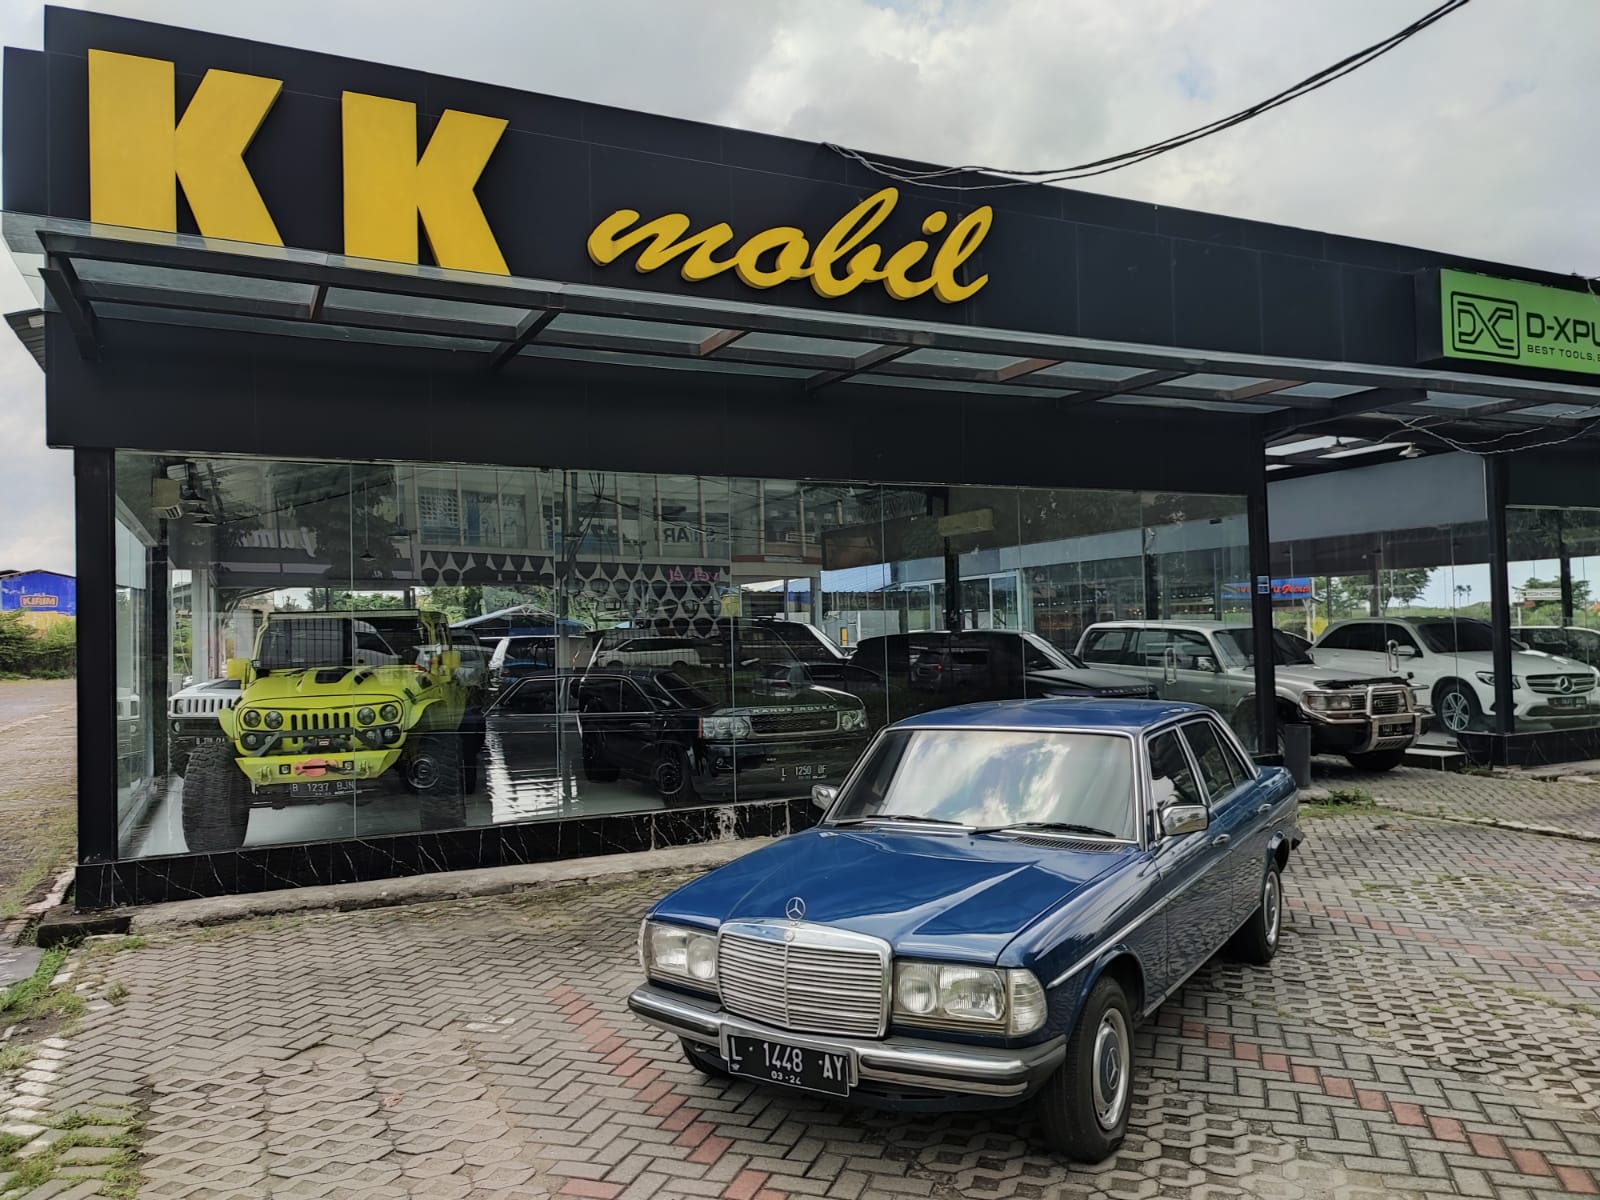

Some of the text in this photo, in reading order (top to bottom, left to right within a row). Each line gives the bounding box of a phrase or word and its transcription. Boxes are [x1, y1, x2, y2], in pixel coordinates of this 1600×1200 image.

[587, 187, 993, 303] mobil
[1527, 345, 1555, 355] BEST
[307, 783, 329, 792] 1237
[731, 1037, 843, 1081] L 1448 AY
